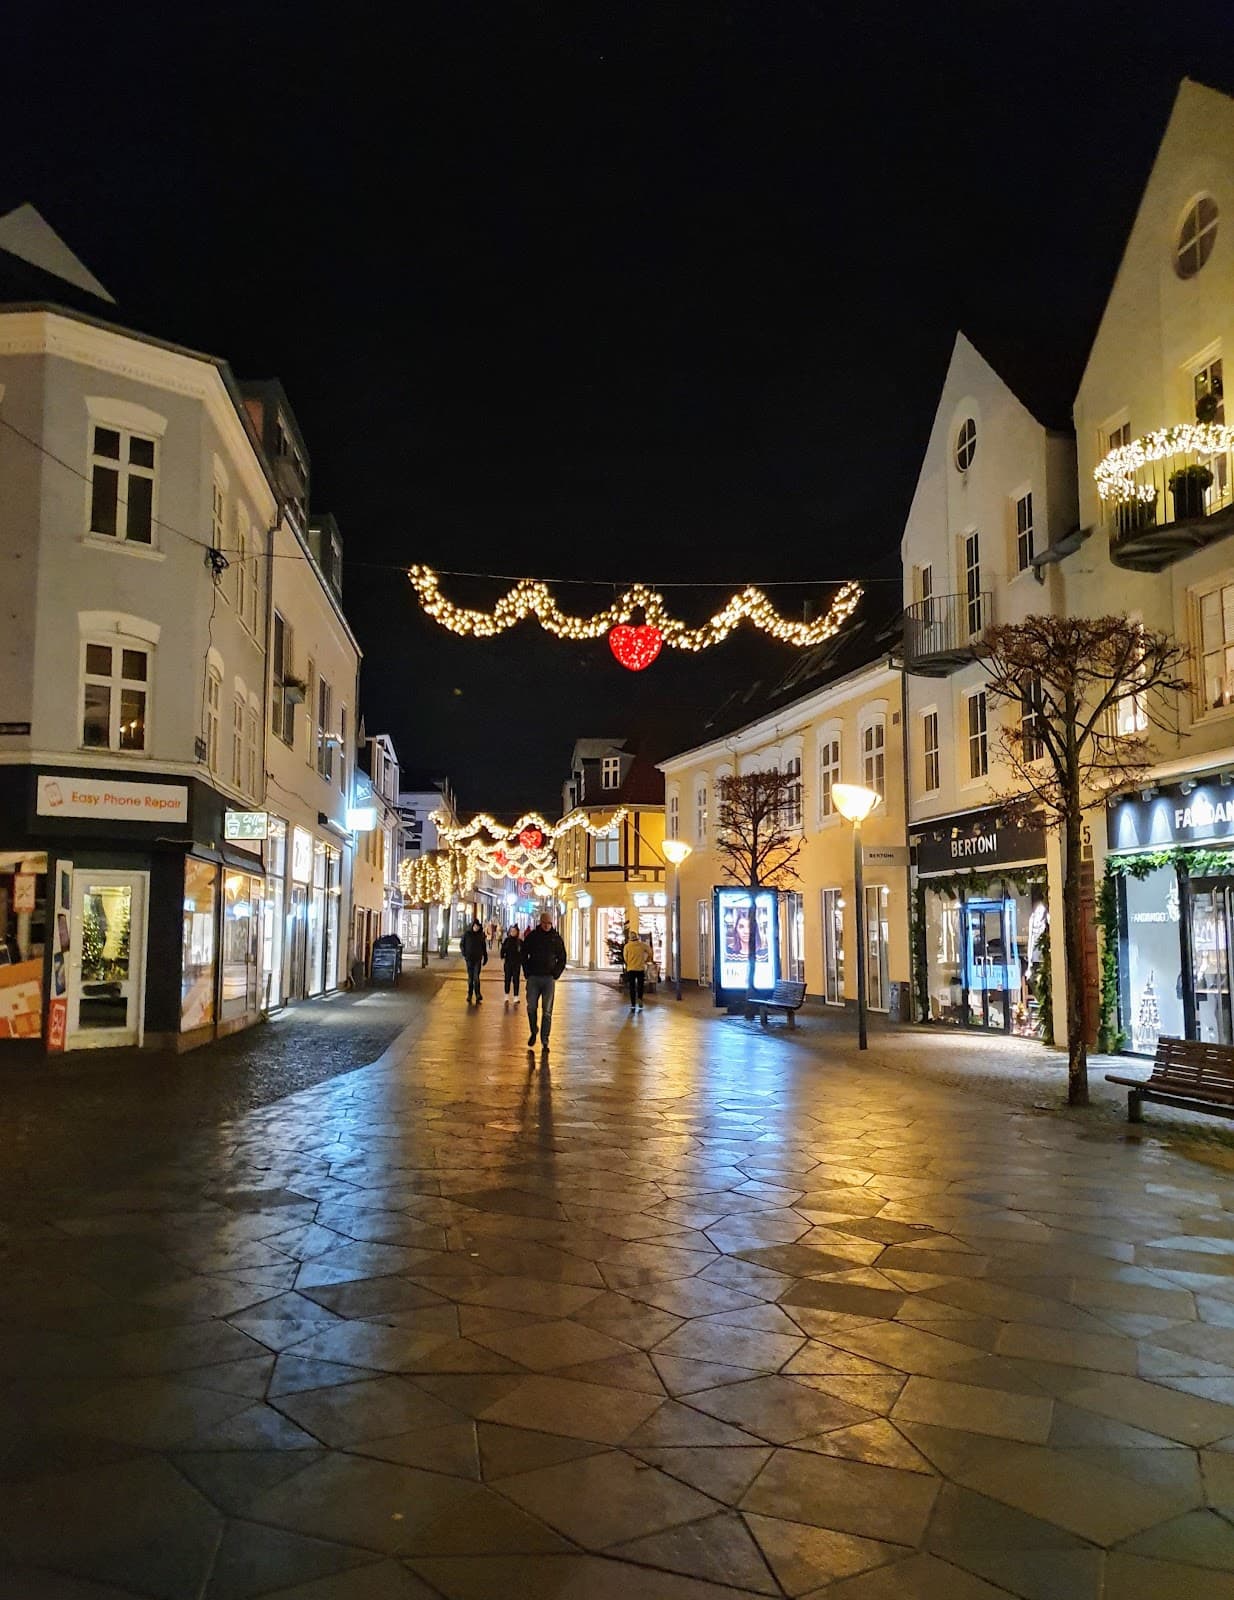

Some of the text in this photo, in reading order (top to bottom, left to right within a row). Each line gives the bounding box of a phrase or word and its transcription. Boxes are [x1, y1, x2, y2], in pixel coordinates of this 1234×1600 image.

[72, 791, 181, 810] Easy Phone Repair
[951, 832, 998, 858] BERTONI
